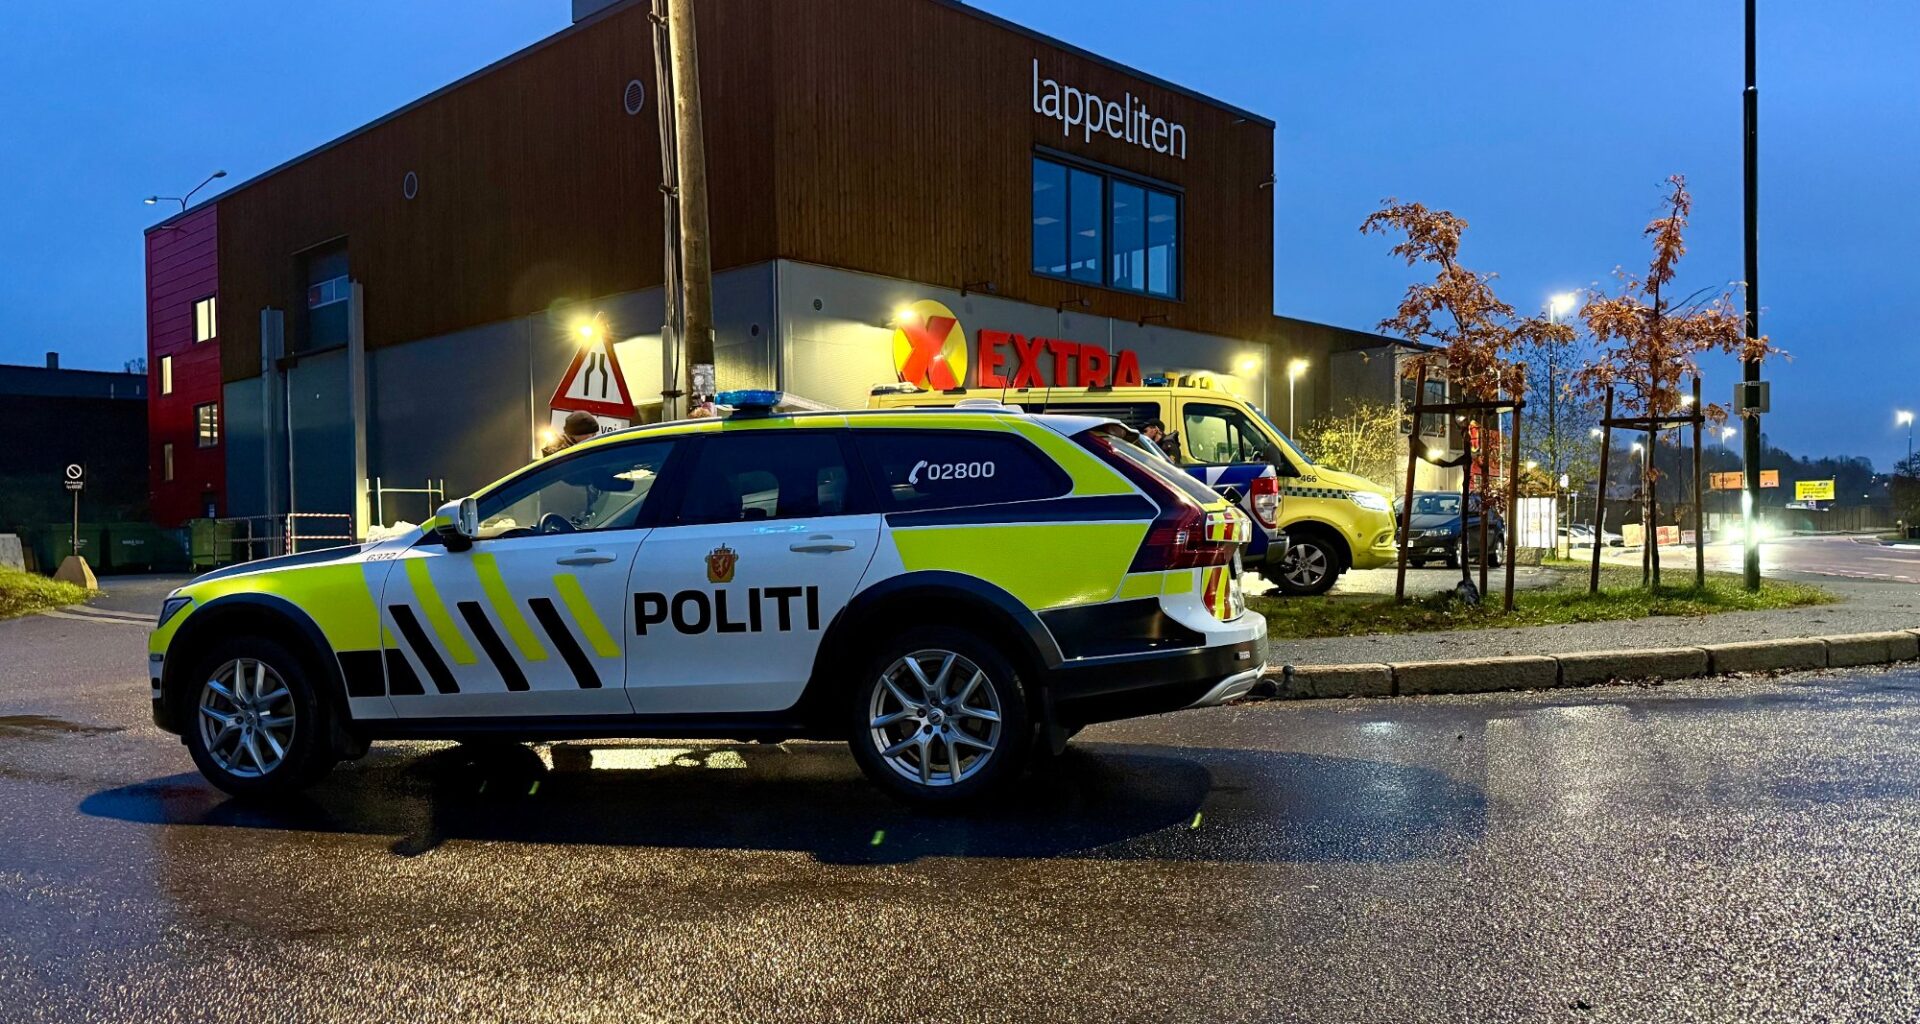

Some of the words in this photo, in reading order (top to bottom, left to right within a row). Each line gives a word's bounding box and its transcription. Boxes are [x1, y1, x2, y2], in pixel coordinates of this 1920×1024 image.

[1033, 58, 1187, 160] lappeliten
[978, 329, 1142, 388] EXTRA
[928, 461, 995, 480] 02800
[1300, 474, 1317, 483] 466
[366, 552, 397, 561] 6372
[634, 585, 820, 636] POLITI
